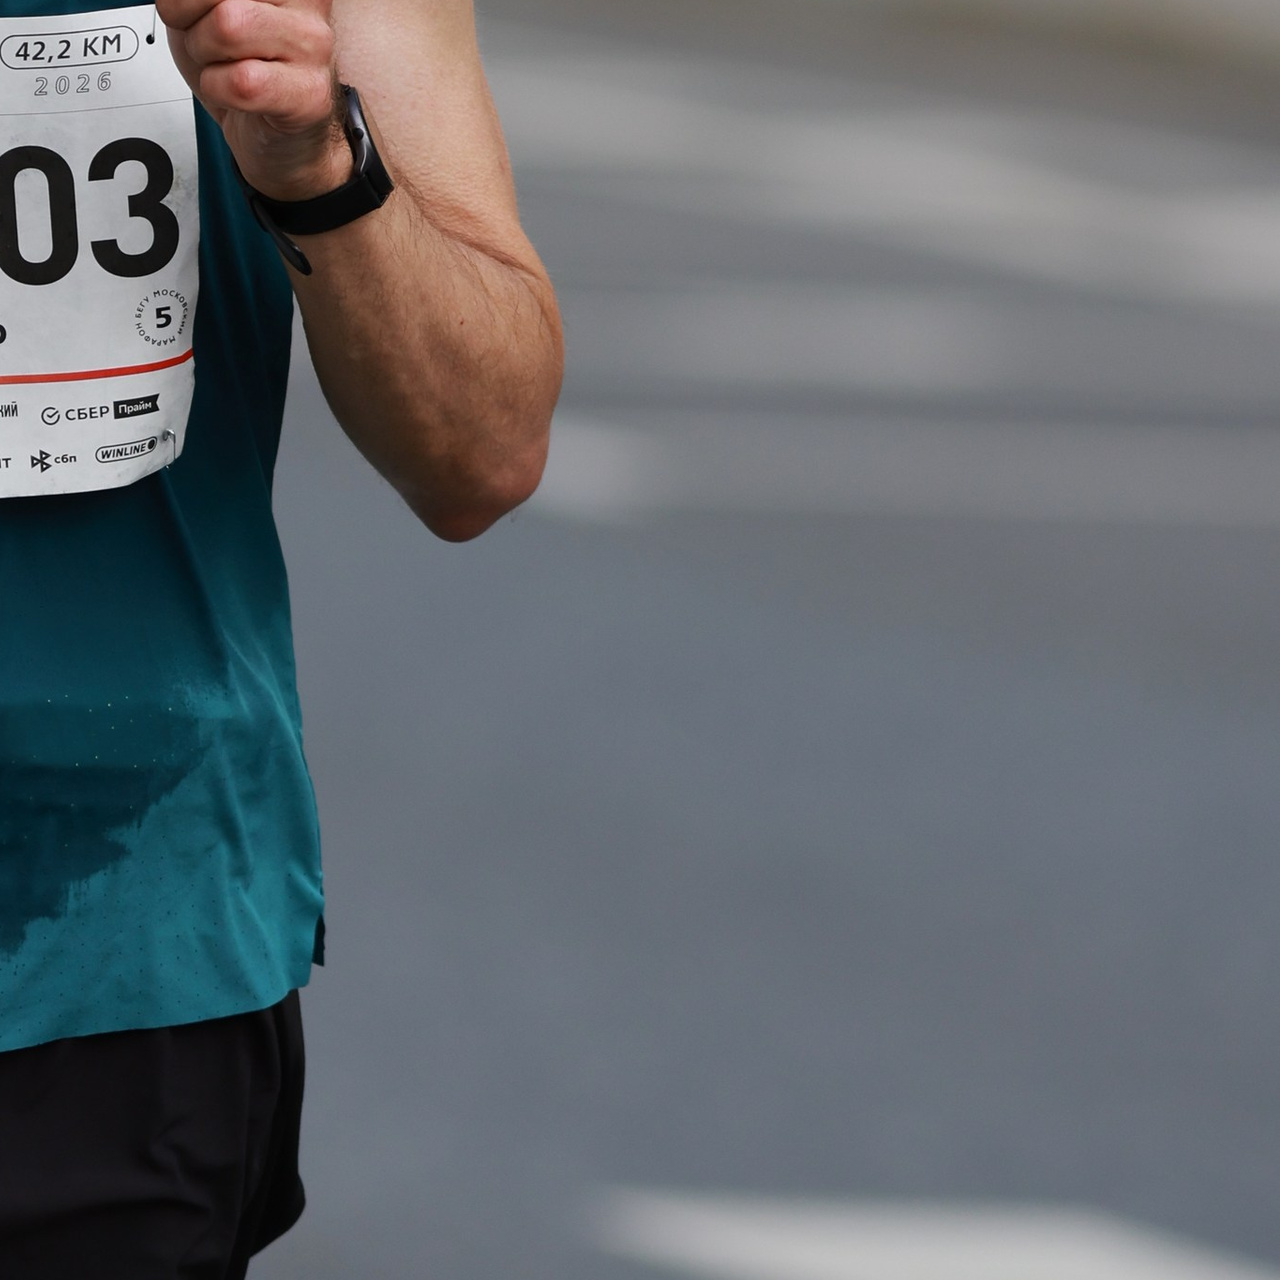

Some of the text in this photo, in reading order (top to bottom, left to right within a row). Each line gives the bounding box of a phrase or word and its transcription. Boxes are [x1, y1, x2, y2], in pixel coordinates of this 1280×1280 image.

[15, 33, 123, 64] 42,2 КМ
[34, 71, 112, 97] 2026
[135, 296, 150, 319] БЕГУ
[155, 305, 173, 329] 5
[135, 322, 176, 347] МАРАФОН
[65, 401, 152, 421] СБЕР Прайм
[54, 453, 77, 464] сбп
[101, 442, 147, 460] WINLINE
